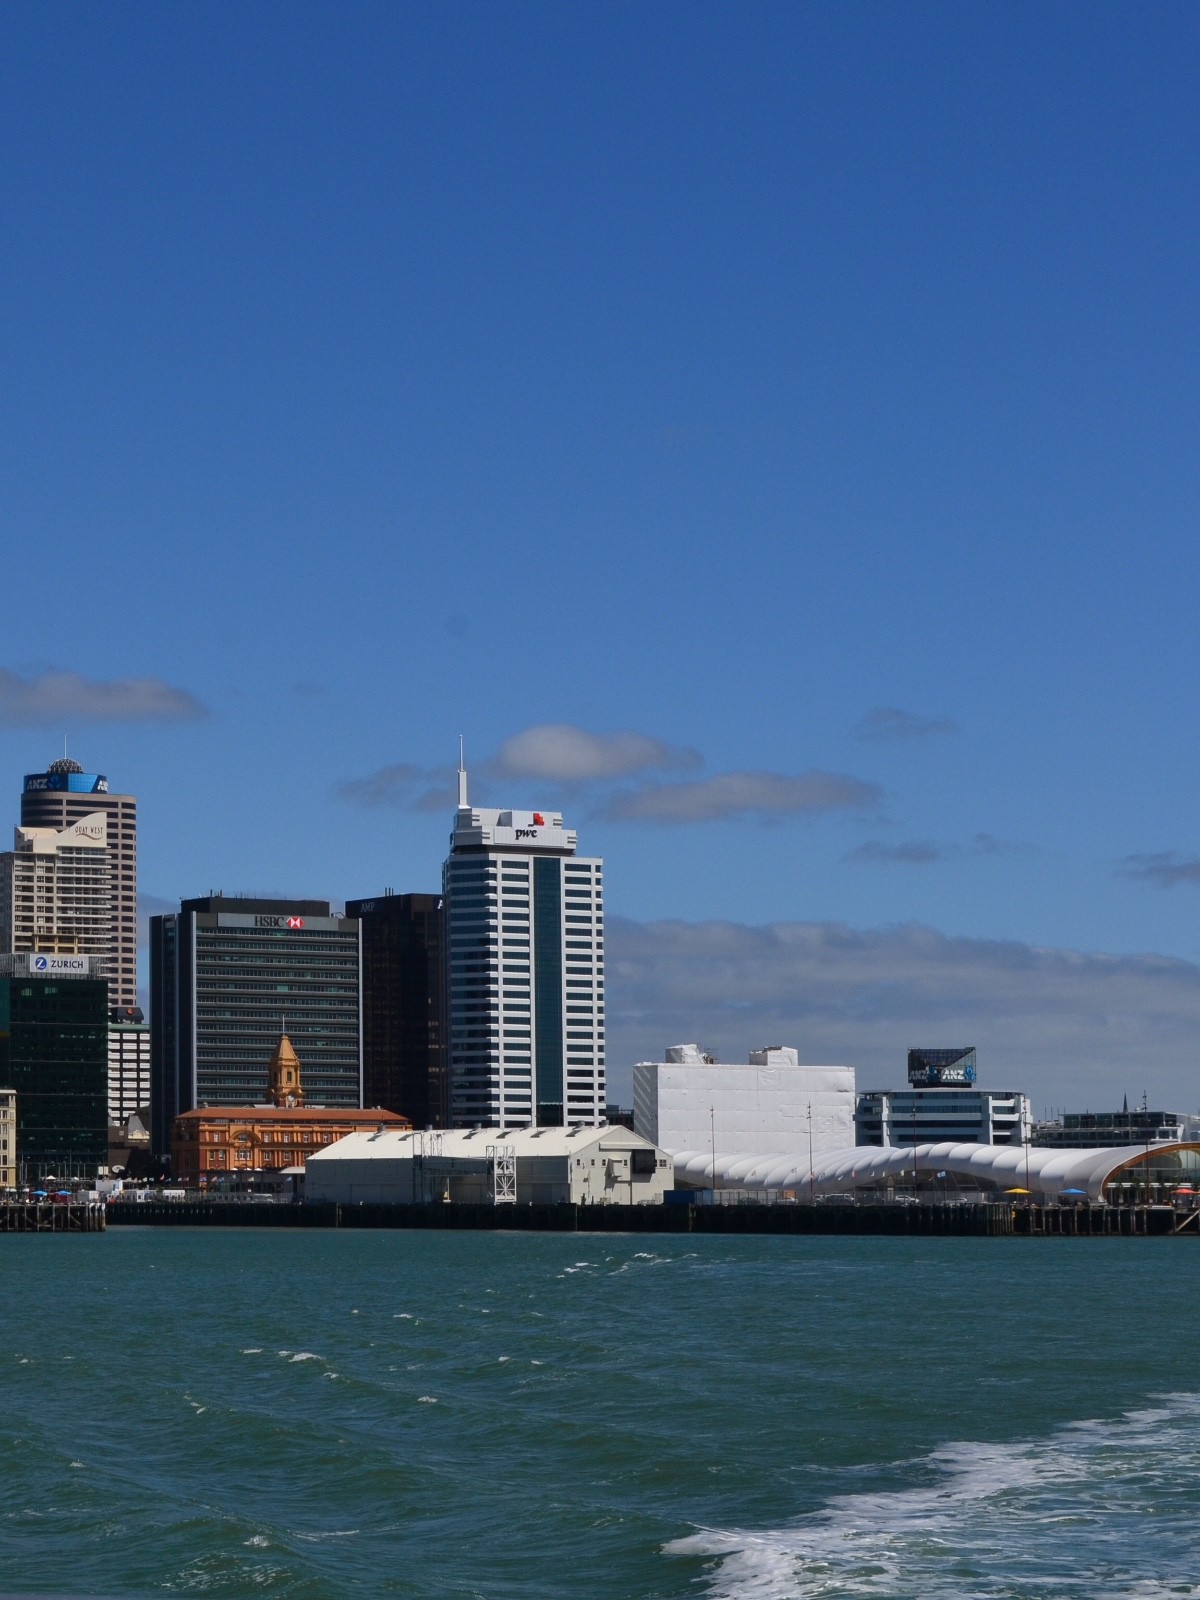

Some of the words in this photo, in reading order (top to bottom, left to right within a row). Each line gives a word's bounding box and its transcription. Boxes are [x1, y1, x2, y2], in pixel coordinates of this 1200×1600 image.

[27, 779, 48, 791] ANZ
[90, 826, 104, 834] WEST
[515, 829, 537, 840] pwc
[254, 916, 285, 928] HSBC
[51, 960, 84, 969] ZURICH
[943, 1069, 965, 1080] ANZ
